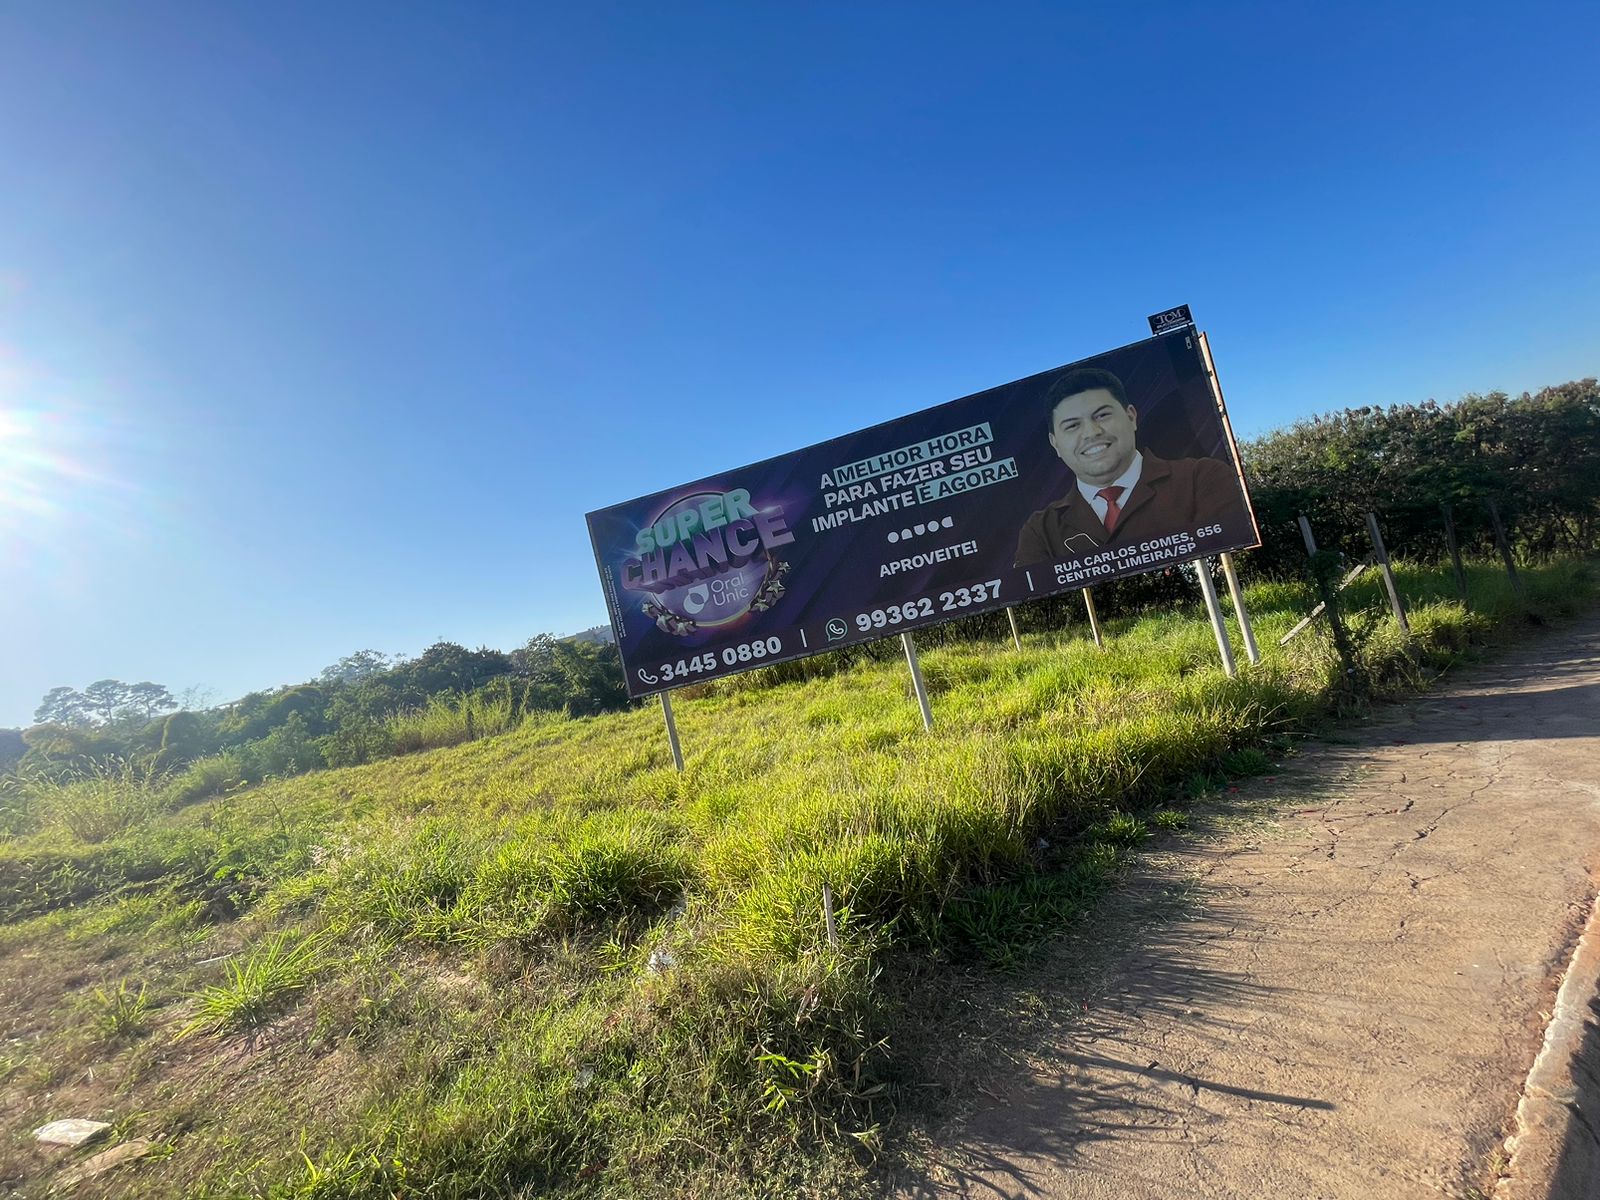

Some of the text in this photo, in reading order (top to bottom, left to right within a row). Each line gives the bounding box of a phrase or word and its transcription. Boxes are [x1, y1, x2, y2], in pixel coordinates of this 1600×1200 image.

[820, 426, 989, 490] A MELHOR HORA
[824, 446, 992, 508] PARA FAZER SEU
[636, 488, 760, 554] SUPER
[812, 461, 1018, 532] IMPLANTE É AGORA!
[620, 505, 795, 594] CHANCE
[880, 540, 978, 577] APROVEITE!
[1054, 523, 1222, 574] RUA CARLOS GOMES, 656
[1057, 542, 1197, 585] CENTRO, LIMEIRA/SP
[711, 574, 745, 593] Oral
[712, 587, 749, 606] Unic
[856, 579, 1002, 632] 99362 2337
[660, 636, 782, 681] 3445 0880
